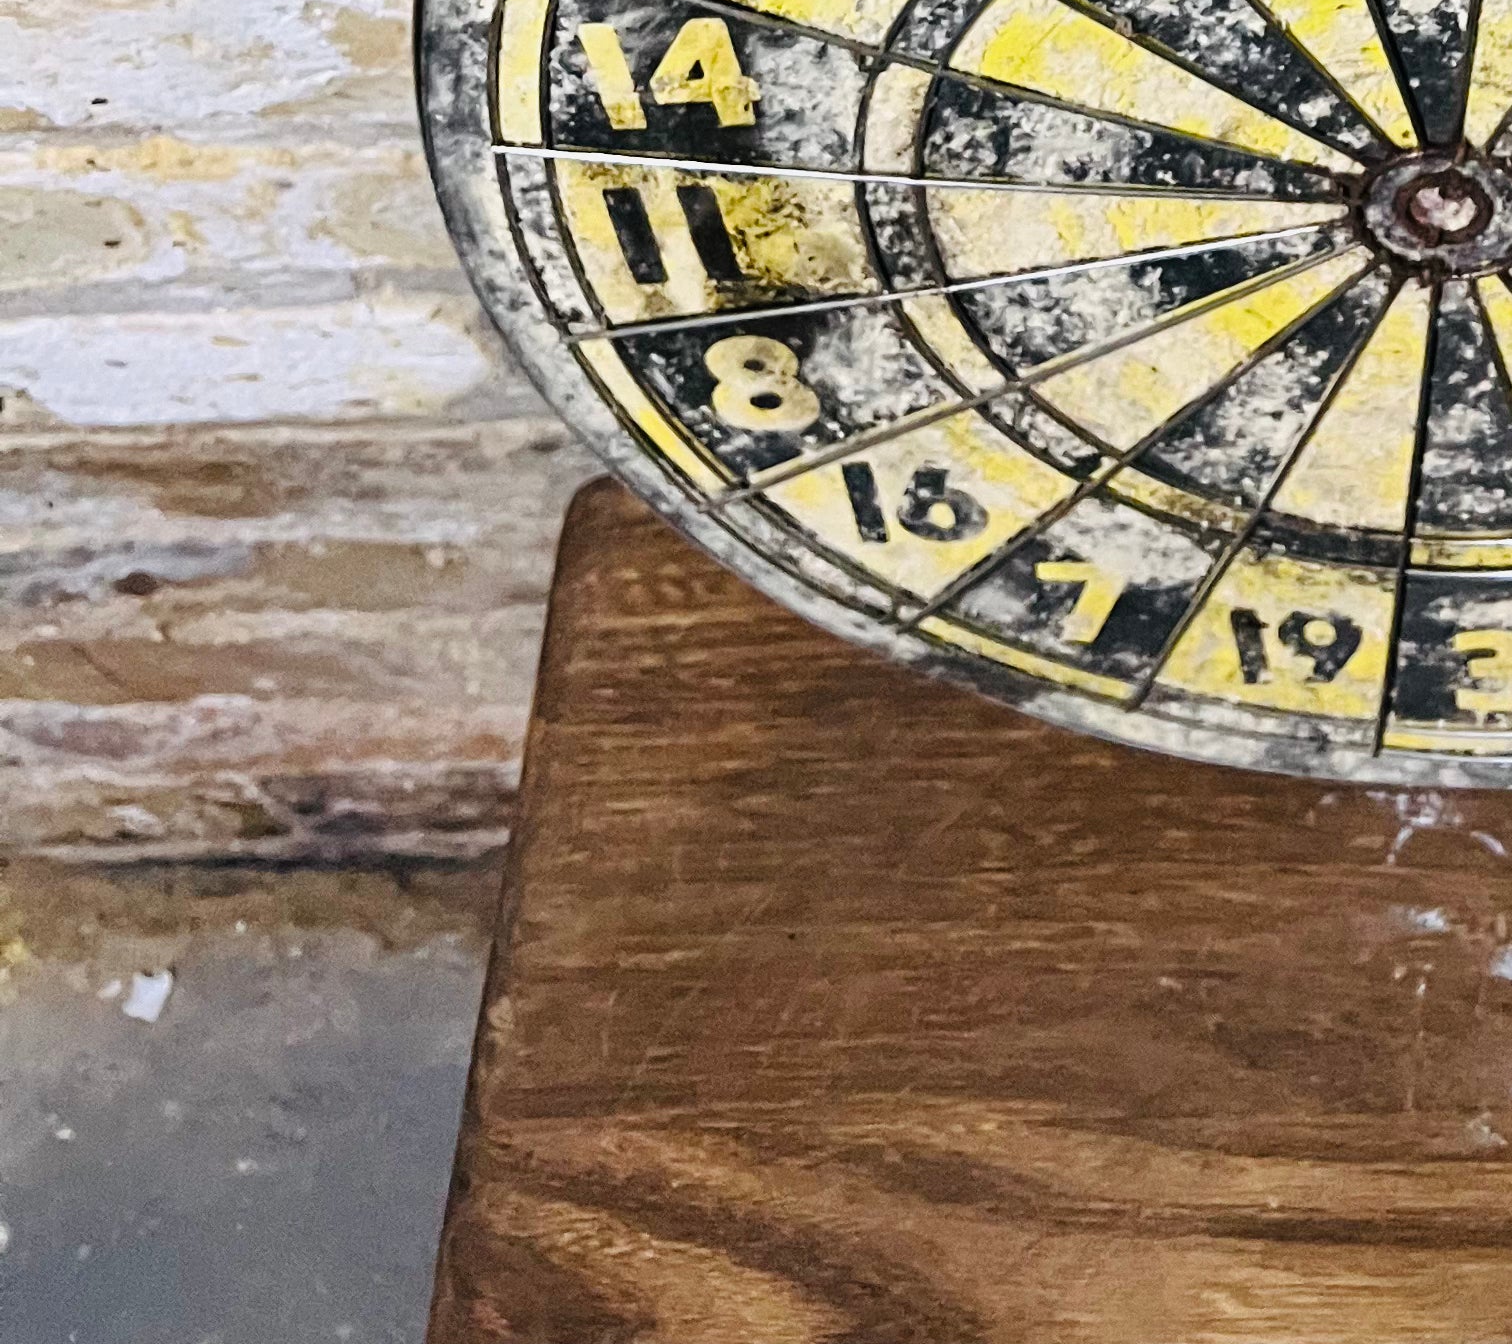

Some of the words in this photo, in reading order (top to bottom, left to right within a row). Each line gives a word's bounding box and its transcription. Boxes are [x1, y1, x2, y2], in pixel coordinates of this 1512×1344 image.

[578, 19, 761, 130] 14
[603, 186, 744, 284] 11
[705, 335, 821, 432] 8
[842, 461, 988, 542] 16
[1035, 560, 1127, 643] 7
[1231, 608, 1362, 684] 19
